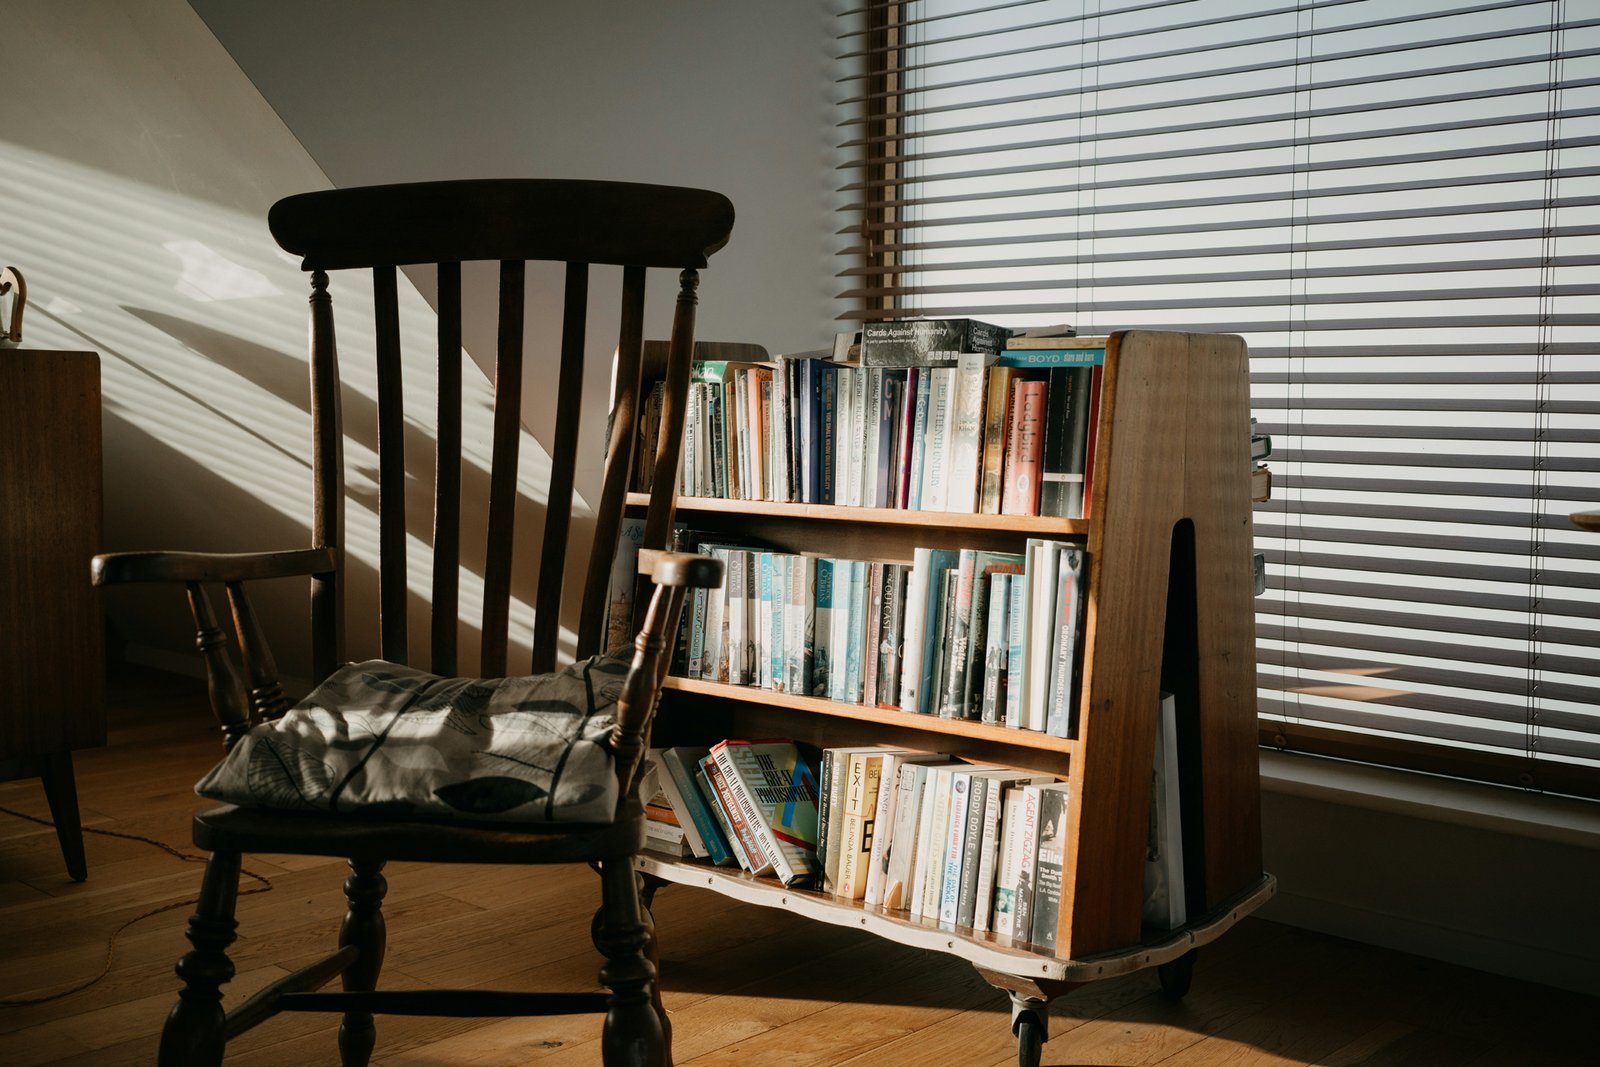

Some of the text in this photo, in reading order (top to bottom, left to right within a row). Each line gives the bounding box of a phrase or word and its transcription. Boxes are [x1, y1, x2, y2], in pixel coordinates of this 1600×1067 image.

[867, 328, 948, 338] Cards Against Humanity
[972, 327, 989, 337] Cards
[972, 336, 992, 347] Against
[1028, 355, 1060, 363] BOYD
[872, 374, 880, 397] CORMAC
[870, 398, 878, 426] McCARTHY
[934, 399, 946, 449] FIFTEENTH
[1018, 393, 1039, 463] Ladybird
[820, 568, 829, 602] O'BRIAN
[883, 585, 892, 630] OUTCAST
[1012, 585, 1022, 643] John Banville
[958, 637, 968, 672] Walter
[1059, 625, 1070, 660] ORDINARY
[1054, 661, 1067, 718] THUNDERSTORMS
[715, 752, 728, 766] THE
[755, 754, 778, 770] THE
[721, 764, 739, 786] GREAT
[762, 770, 794, 786] GREAT
[852, 762, 862, 811] EXIT
[731, 783, 762, 833] PHILOSOPHERS
[831, 786, 840, 808] DUFFY
[882, 777, 892, 815] STRANGE
[972, 781, 983, 814] RODDY
[988, 787, 998, 811] FEVER
[952, 797, 963, 859] FREDERICK FORSYTH
[968, 818, 978, 850] DOYLE
[986, 816, 996, 838] PITCH
[1020, 793, 1037, 868] AGENT ZIGZAG
[844, 818, 856, 880] BELINDA BAUER
[932, 832, 940, 858] GIFTS
[944, 879, 952, 904] JACKAL
[950, 896, 955, 904] OF
[961, 889, 969, 906] Henry
[1016, 888, 1024, 928] MACINTYRE
